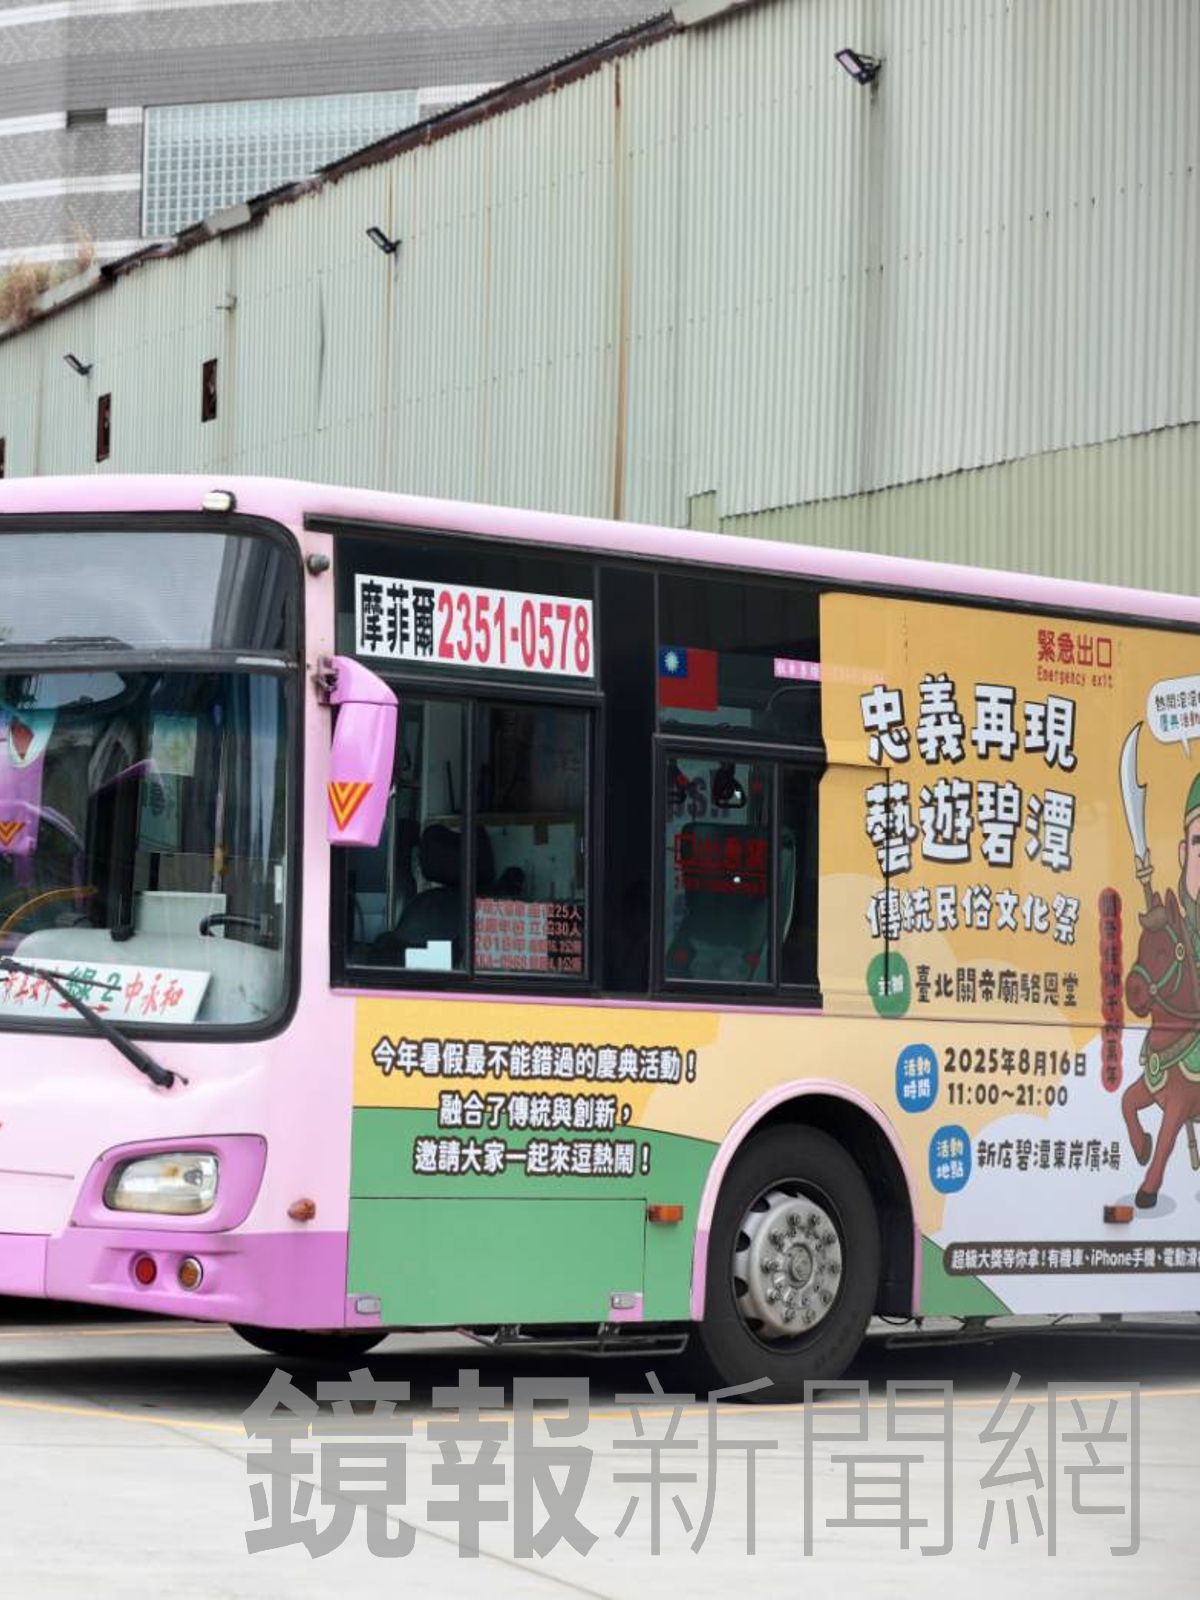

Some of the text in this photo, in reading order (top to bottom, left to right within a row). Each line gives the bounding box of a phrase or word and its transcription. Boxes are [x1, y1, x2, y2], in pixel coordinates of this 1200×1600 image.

[359, 579, 591, 674] 摩菲爾 2351-0578
[1037, 628, 1113, 669] 緊急出口
[1037, 665, 1113, 688] Emergency exit
[1154, 689, 1200, 712] 熱鬧滾滾
[859, 672, 1077, 772] 忠義再現
[864, 777, 1076, 876] 藝遊碧潭
[866, 884, 1081, 944] 傳統民俗文化祭
[123, 970, 186, 1016] 中永和
[915, 964, 1079, 1007] 臺北關帝廟駱恩堂
[372, 1037, 697, 1083] 今年暑假最不能錯過的慶典活動！
[904, 1058, 931, 1078] 活動
[943, 1046, 1088, 1077] 2025年8月16日
[903, 1080, 931, 1099] 時間
[438, 1092, 633, 1130] 融合了傳統與創新，
[413, 1137, 651, 1175] 邀請大家一起來逗熱鬧！
[936, 1137, 964, 1158] 活動
[976, 1138, 1122, 1172] 新店碧潭東岸廣場
[936, 1161, 964, 1180] 地點
[951, 1247, 1200, 1270] 超級大獎等你拿！有機車、iPhone手機、電動滑
